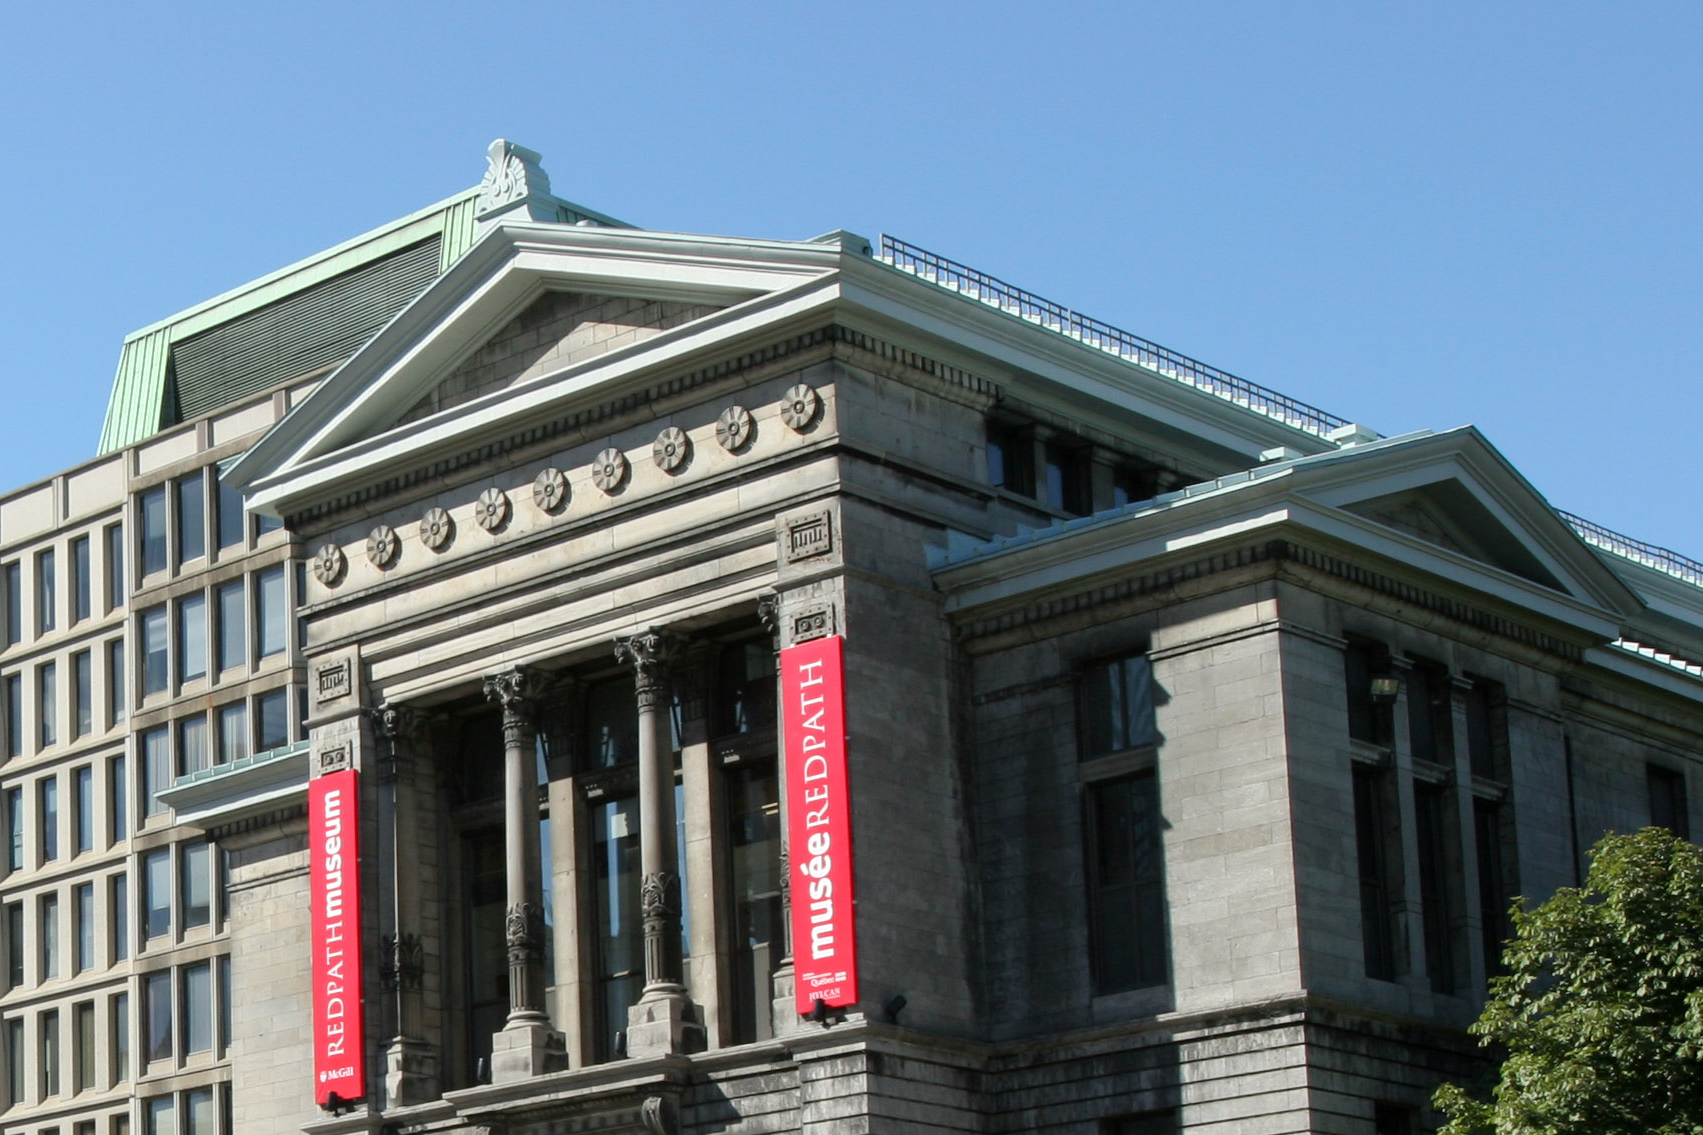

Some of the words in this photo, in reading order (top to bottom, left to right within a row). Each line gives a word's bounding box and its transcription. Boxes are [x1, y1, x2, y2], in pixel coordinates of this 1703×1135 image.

[799, 658, 830, 830] REDPATH
[323, 789, 343, 919] museum
[799, 831, 835, 960] musée
[325, 920, 345, 1057] REDPATH
[327, 1066, 354, 1080] McGill
